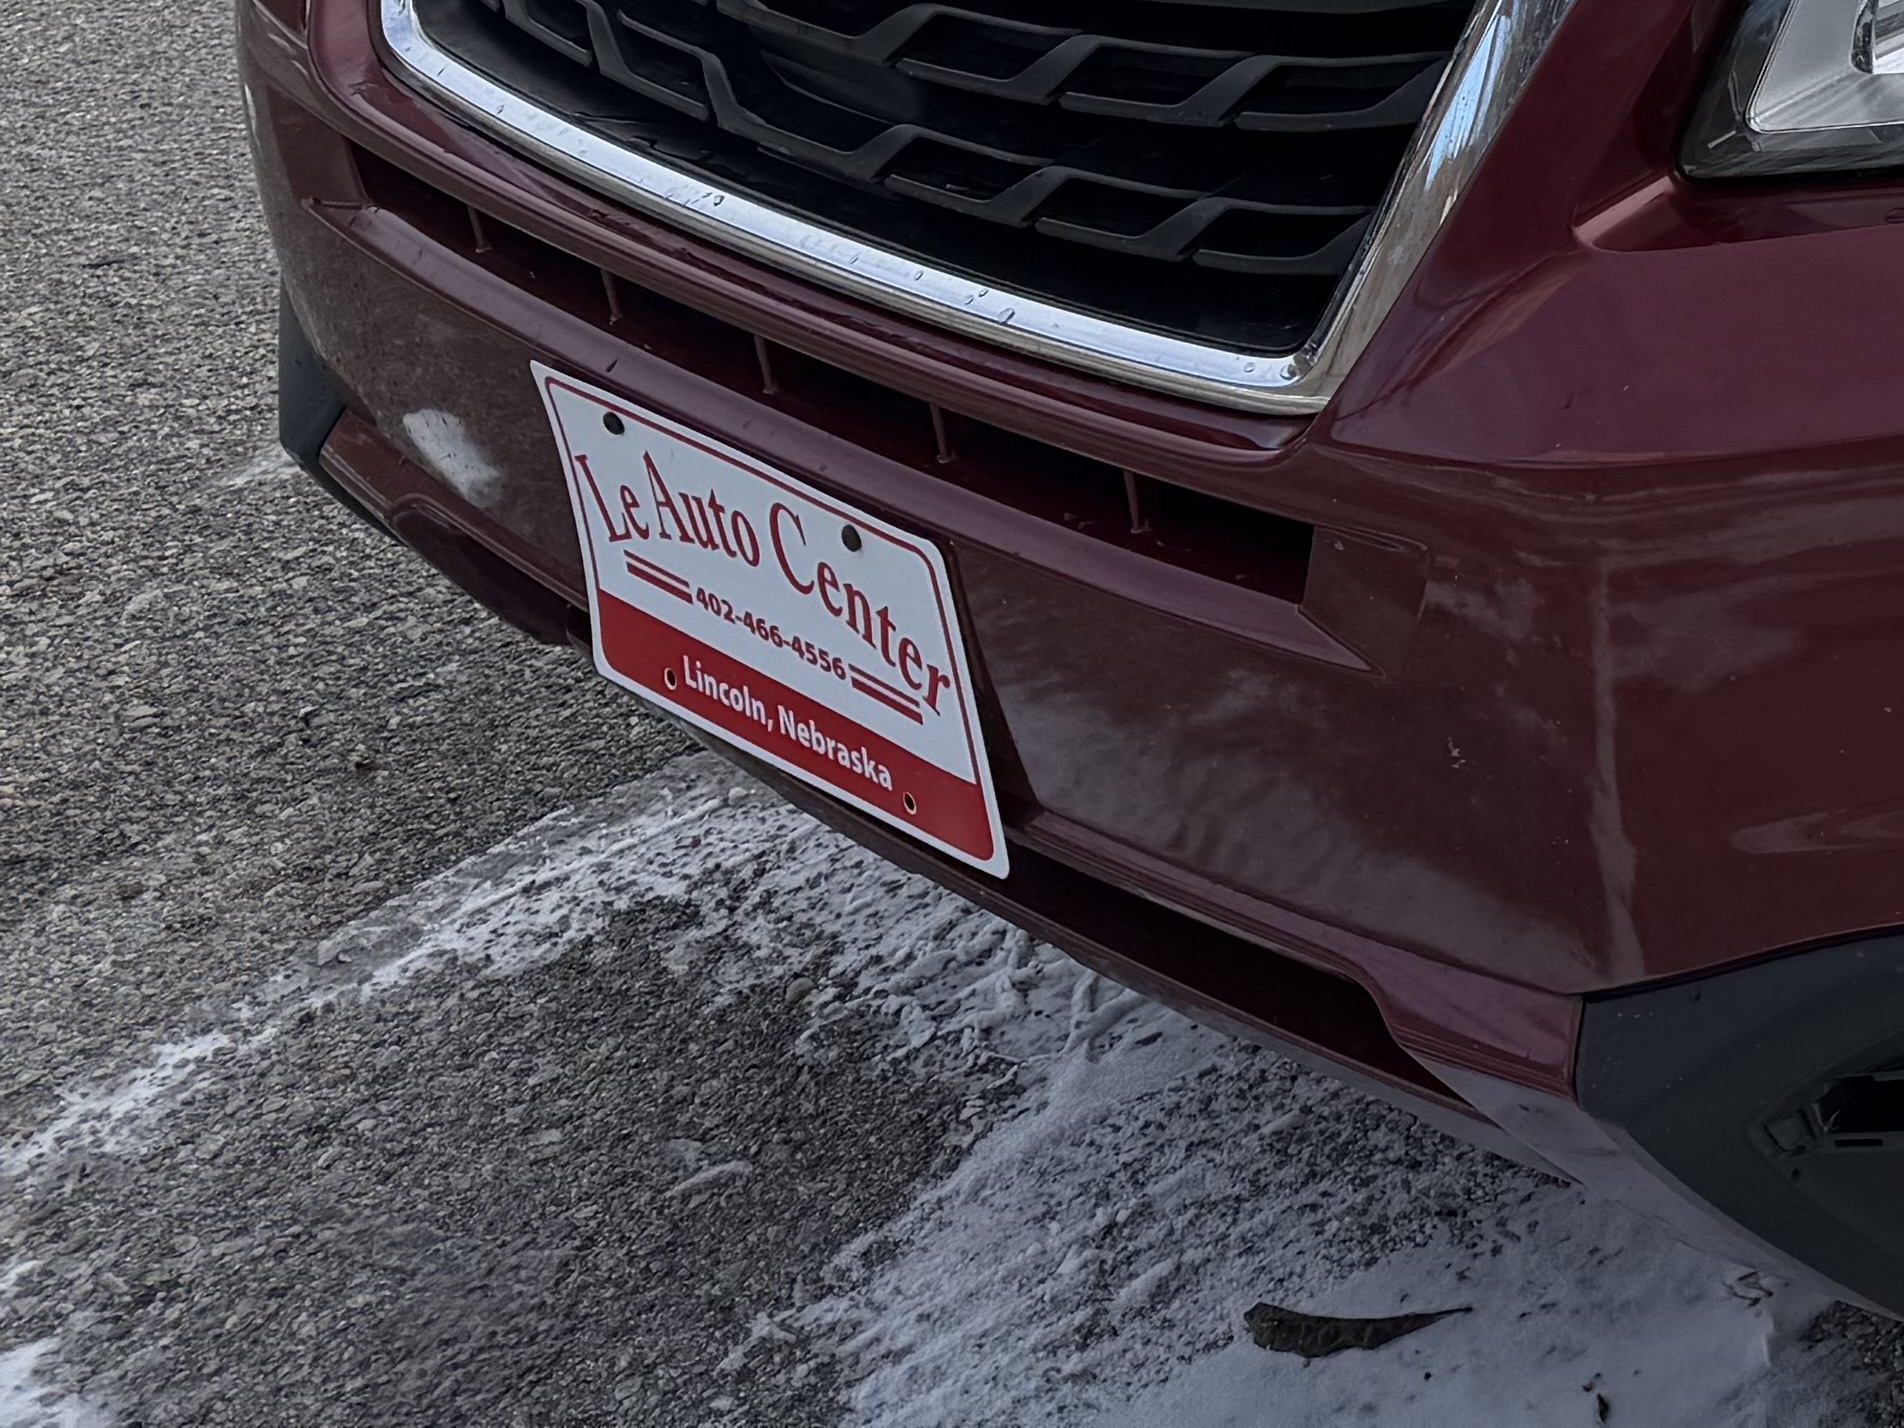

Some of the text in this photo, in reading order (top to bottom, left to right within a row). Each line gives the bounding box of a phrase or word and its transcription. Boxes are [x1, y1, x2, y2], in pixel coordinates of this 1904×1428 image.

[695, 586, 847, 681] 402-466-4556
[769, 501, 952, 716] Center
[682, 654, 893, 792] Lincoln, Nebraska
